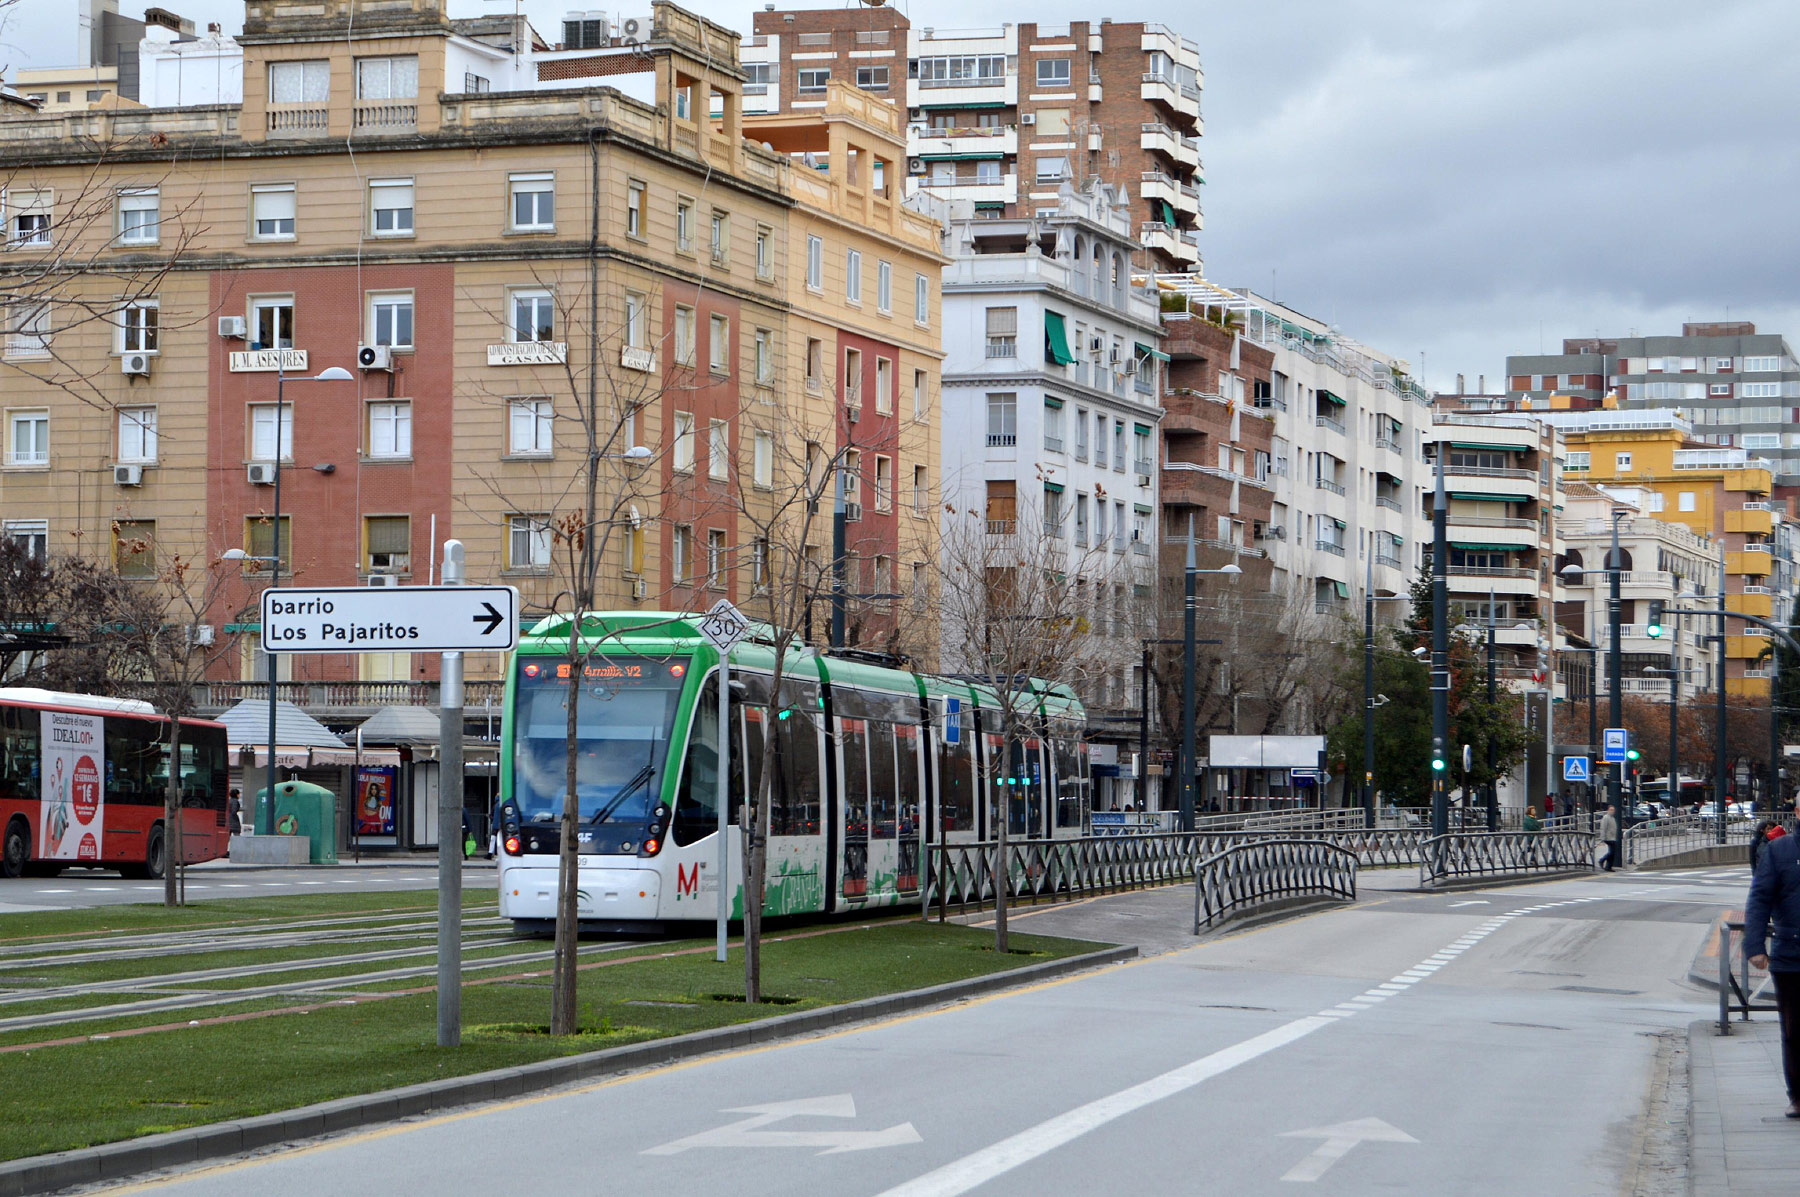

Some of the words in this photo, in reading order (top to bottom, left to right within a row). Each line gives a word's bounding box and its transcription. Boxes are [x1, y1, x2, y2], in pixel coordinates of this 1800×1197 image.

[255, 351, 305, 367] ASESORES
[502, 355, 554, 363] GASAN
[271, 597, 335, 614] barrio
[271, 624, 307, 640] Los
[321, 622, 419, 643] Pajaritos
[712, 619, 736, 636] 30
[625, 666, 642, 677] V2
[52, 713, 74, 726] Descubre
[79, 718, 93, 728] nuevo
[379, 806, 392, 820] ON
